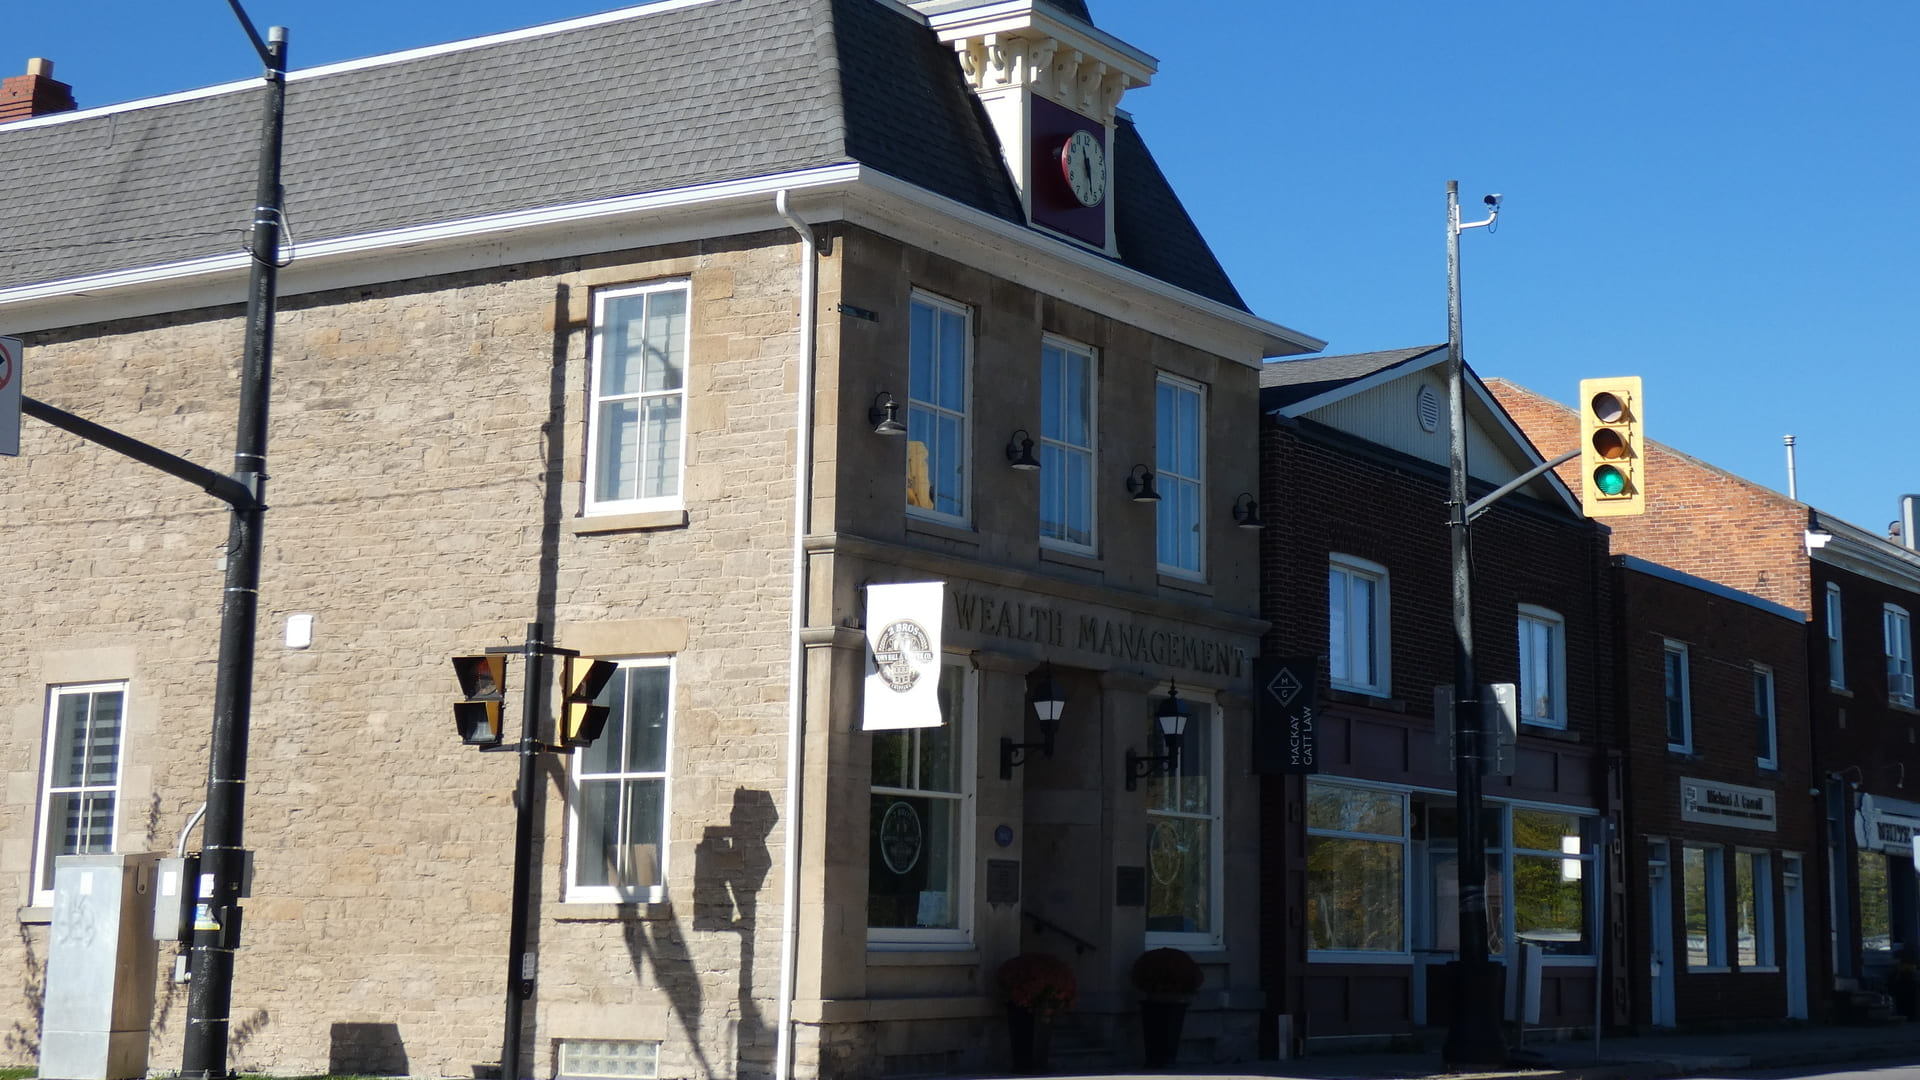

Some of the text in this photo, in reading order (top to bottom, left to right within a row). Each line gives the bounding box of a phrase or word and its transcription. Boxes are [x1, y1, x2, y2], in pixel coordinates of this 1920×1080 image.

[888, 623, 919, 636] 2 BROS
[952, 591, 1245, 678] WEALTH MANAGEMENT
[1281, 689, 1289, 698] G
[1290, 715, 1300, 765] MACKAY
[1303, 706, 1313, 765] GATT LAW
